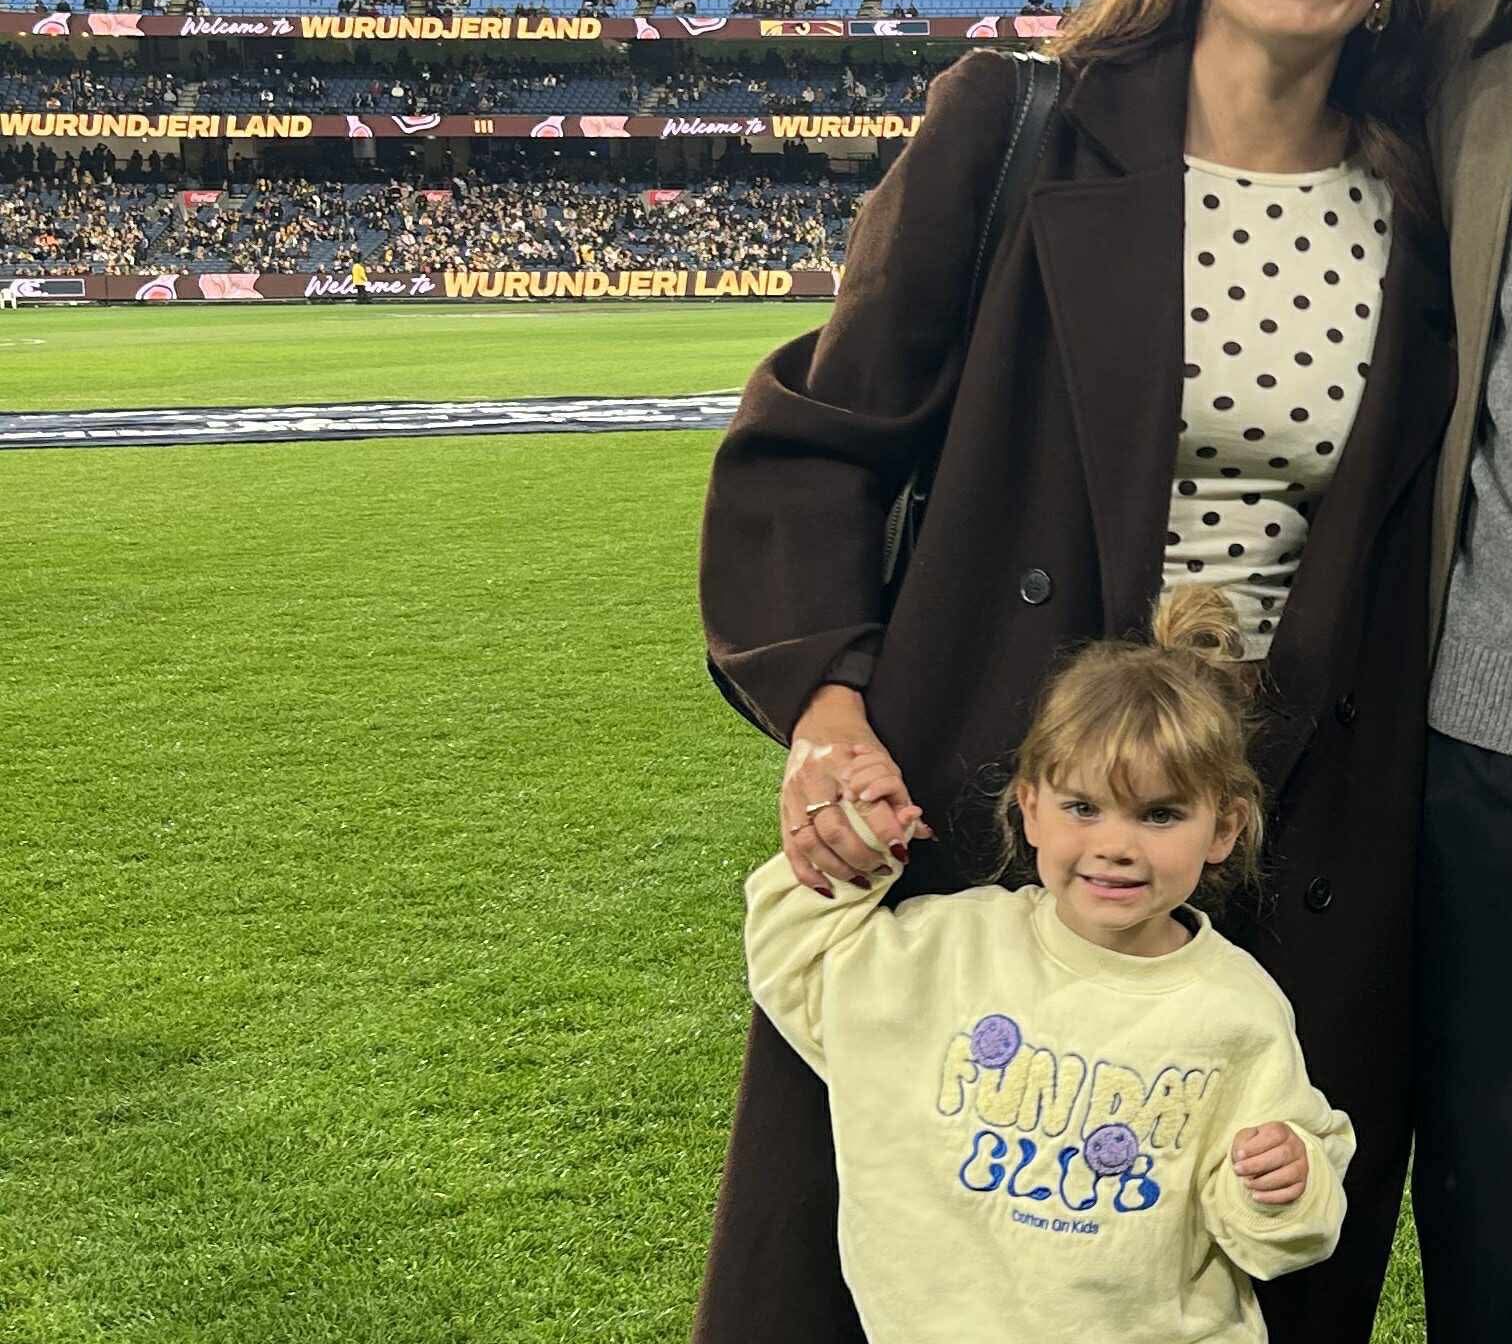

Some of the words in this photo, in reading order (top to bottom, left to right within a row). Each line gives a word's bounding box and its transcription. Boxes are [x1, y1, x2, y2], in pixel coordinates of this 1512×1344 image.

[181, 16, 269, 36] Welcome
[271, 16, 294, 36] to
[300, 15, 512, 39] WURUNDJERI
[516, 17, 601, 40] LAND
[0, 112, 221, 138] WURUNDJERI
[225, 114, 313, 138] LAND
[662, 118, 744, 137] Welcome
[746, 116, 767, 136] to
[772, 114, 922, 138] WURUNDJ
[304, 275, 406, 298] Welcme
[409, 274, 436, 296] to
[443, 270, 688, 298] WURUNDJERI
[694, 269, 793, 297] LAND
[960, 1130, 1161, 1213] CLUB
[1012, 1208, 1050, 1230] Cotton
[1052, 1218, 1070, 1232] On
[1072, 1220, 1100, 1234] Kids
